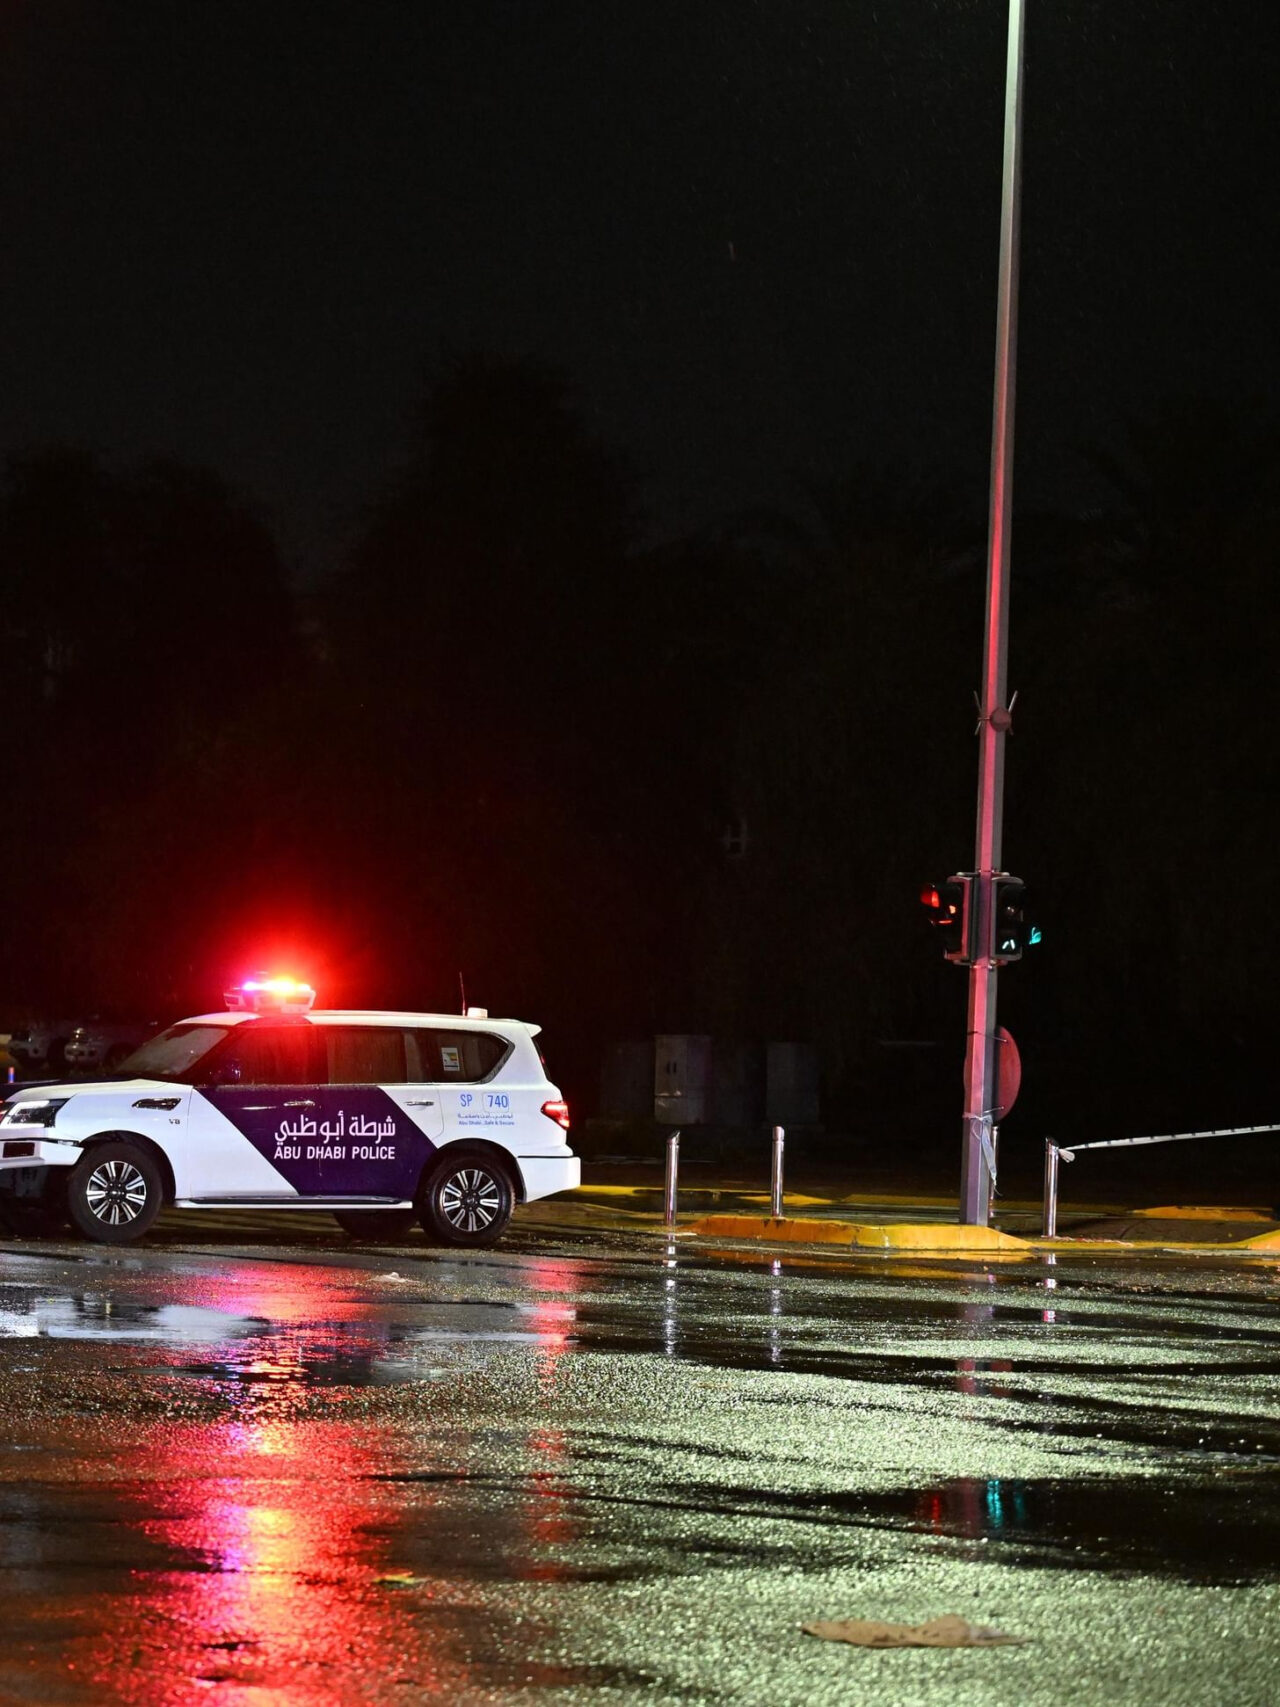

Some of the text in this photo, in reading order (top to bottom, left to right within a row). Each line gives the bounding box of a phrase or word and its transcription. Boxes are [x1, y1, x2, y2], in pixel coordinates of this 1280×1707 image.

[460, 1094, 508, 1108] SP 740
[348, 1114, 396, 1144] شرطة
[274, 1146, 396, 1159] ABU DHABI POLICE
